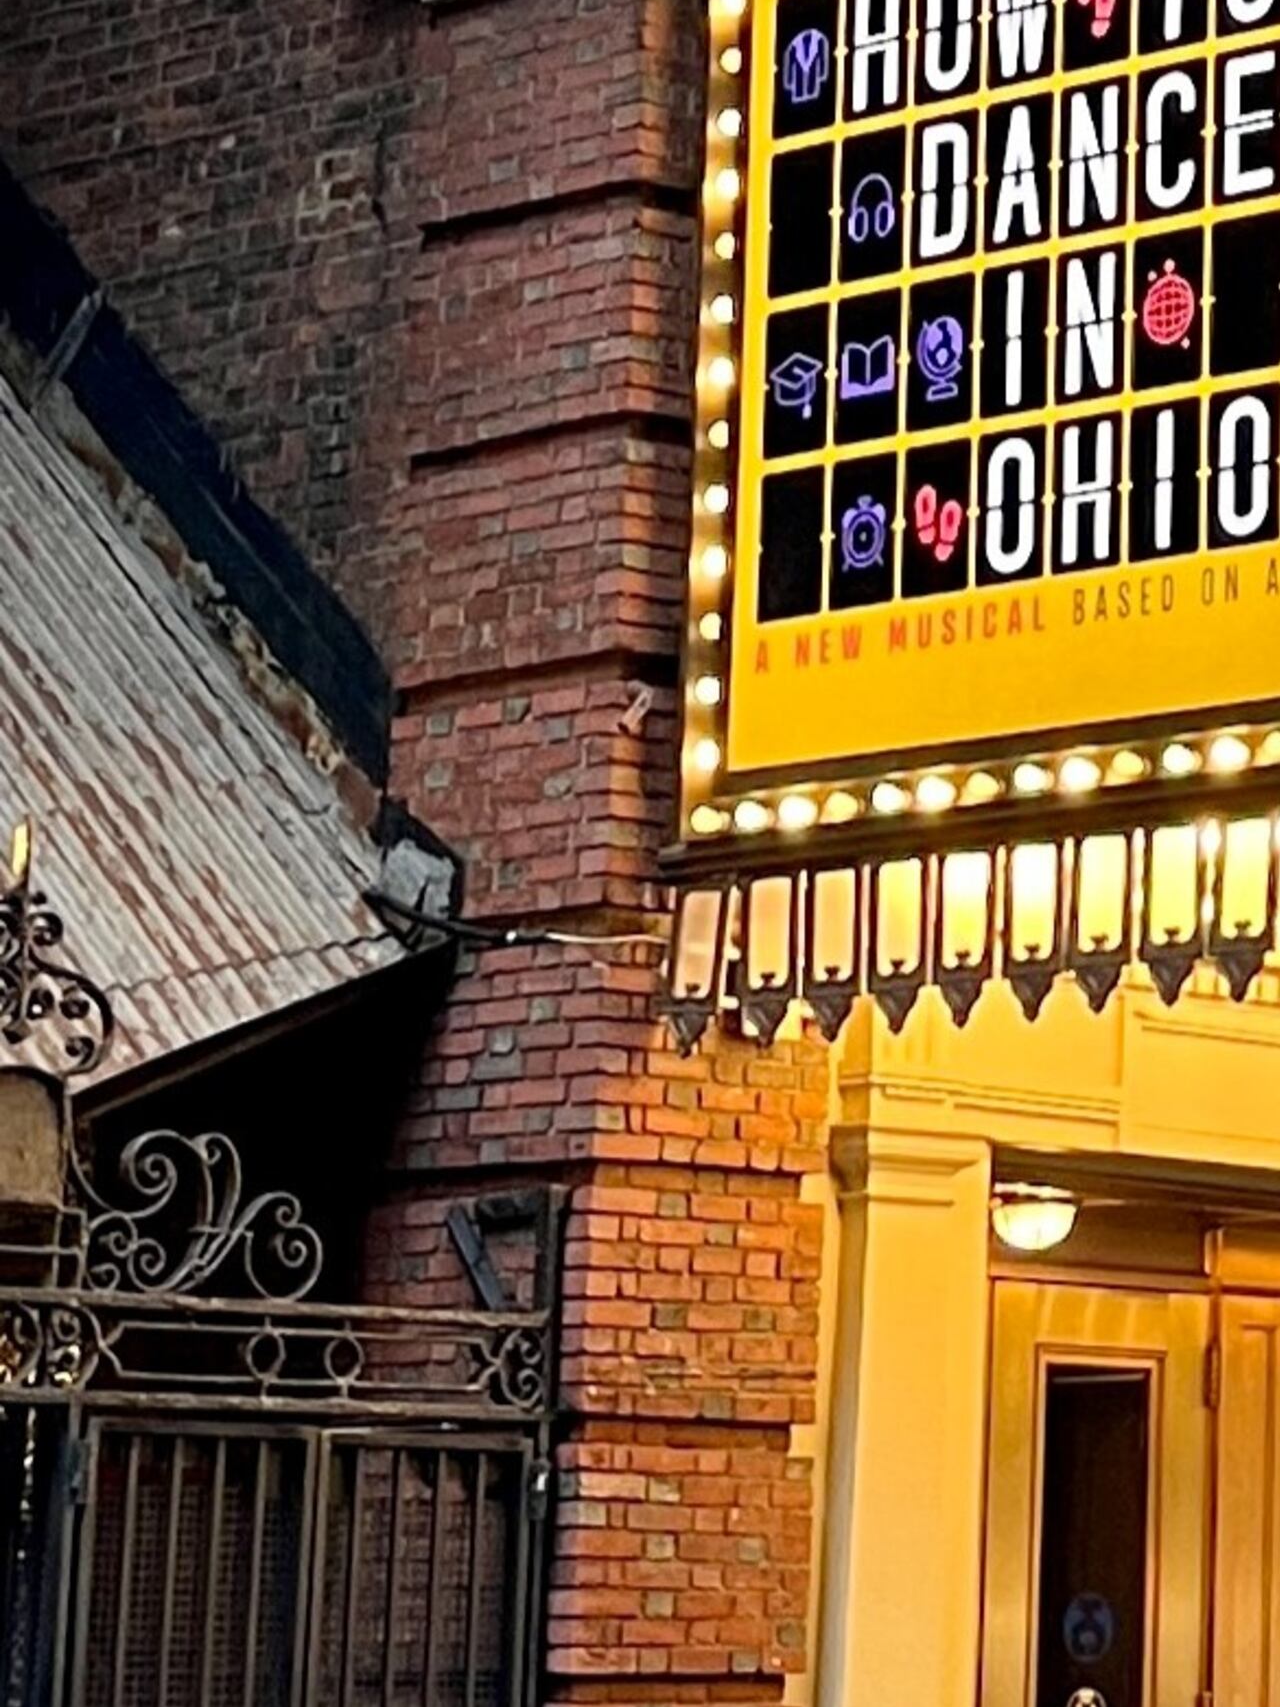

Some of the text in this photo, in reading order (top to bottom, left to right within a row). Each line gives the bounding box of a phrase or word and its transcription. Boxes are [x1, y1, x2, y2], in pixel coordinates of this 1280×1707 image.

[919, 49, 1276, 259] DANCE
[1004, 251, 1117, 407] IN
[985, 394, 1271, 575] OHIO
[754, 640, 770, 675] A
[794, 626, 863, 669] NEW
[887, 597, 1048, 655] MUSICAL
[1072, 580, 1177, 625] BASED
[1201, 566, 1241, 605] ON
[1265, 560, 1280, 596] A
